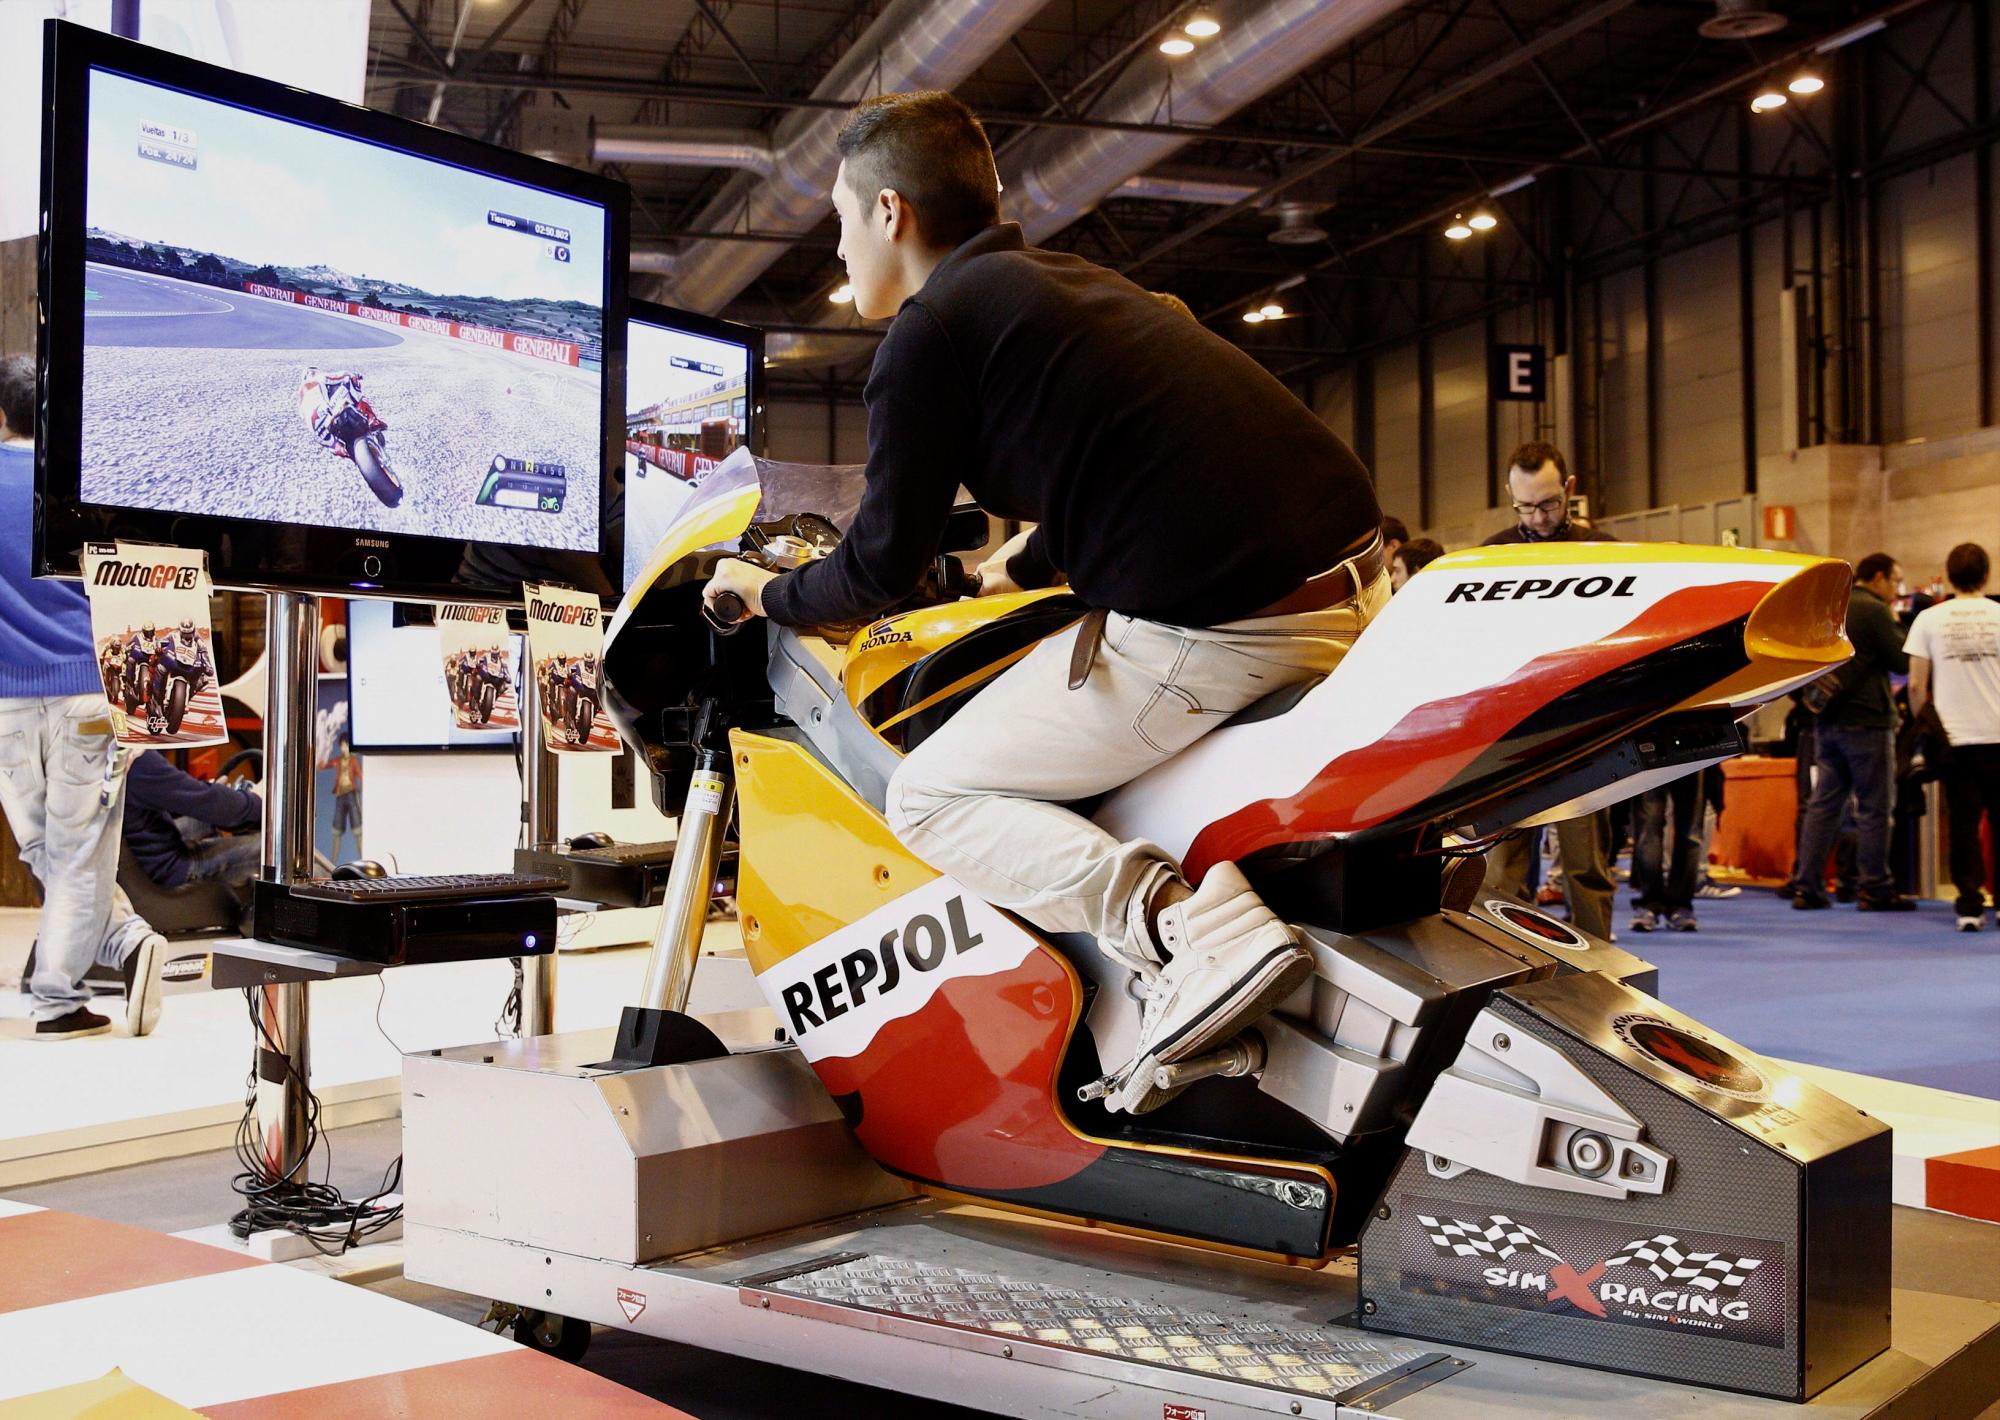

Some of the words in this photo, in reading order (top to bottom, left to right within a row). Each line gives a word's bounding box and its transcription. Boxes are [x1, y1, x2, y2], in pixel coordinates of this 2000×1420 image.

[490, 211, 516, 227] Tiempo
[250, 283, 295, 302] GENERALI
[304, 295, 350, 314] GENERALI
[357, 306, 400, 325] GENERALI
[408, 316, 450, 336] GENERALI
[459, 326, 504, 348] GENERALI
[513, 336, 571, 364] GENERALI
[1509, 352, 1532, 393] E
[355, 538, 390, 549] SAMSUNG
[1445, 575, 1638, 604] REPSOL
[860, 631, 913, 653] HONDA
[781, 894, 984, 1037] REPSOL
[1622, 1309, 1640, 1320] By
